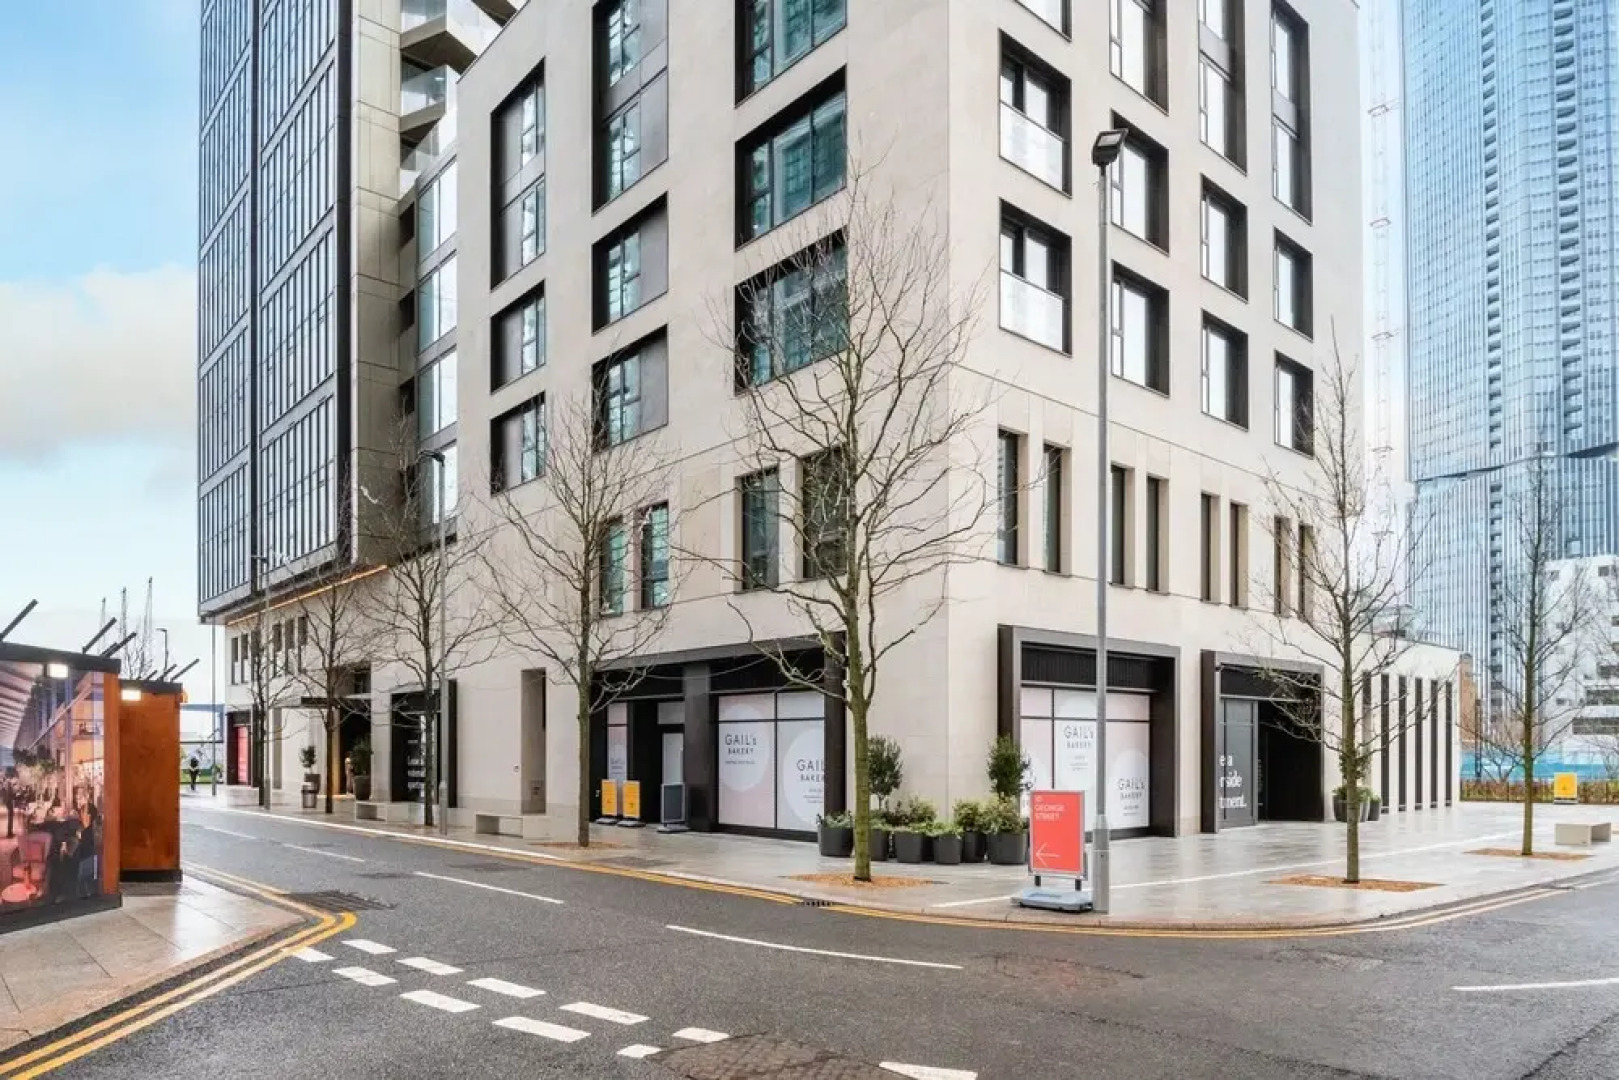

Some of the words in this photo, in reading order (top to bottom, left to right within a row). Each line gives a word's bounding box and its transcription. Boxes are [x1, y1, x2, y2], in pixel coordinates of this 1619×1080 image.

[1064, 725, 1094, 739] GAIL's
[725, 734, 756, 745] GAIL's
[728, 747, 754, 755] BAKERY
[1034, 804, 1065, 812] GEORGE
[1034, 812, 1060, 821] STREET
